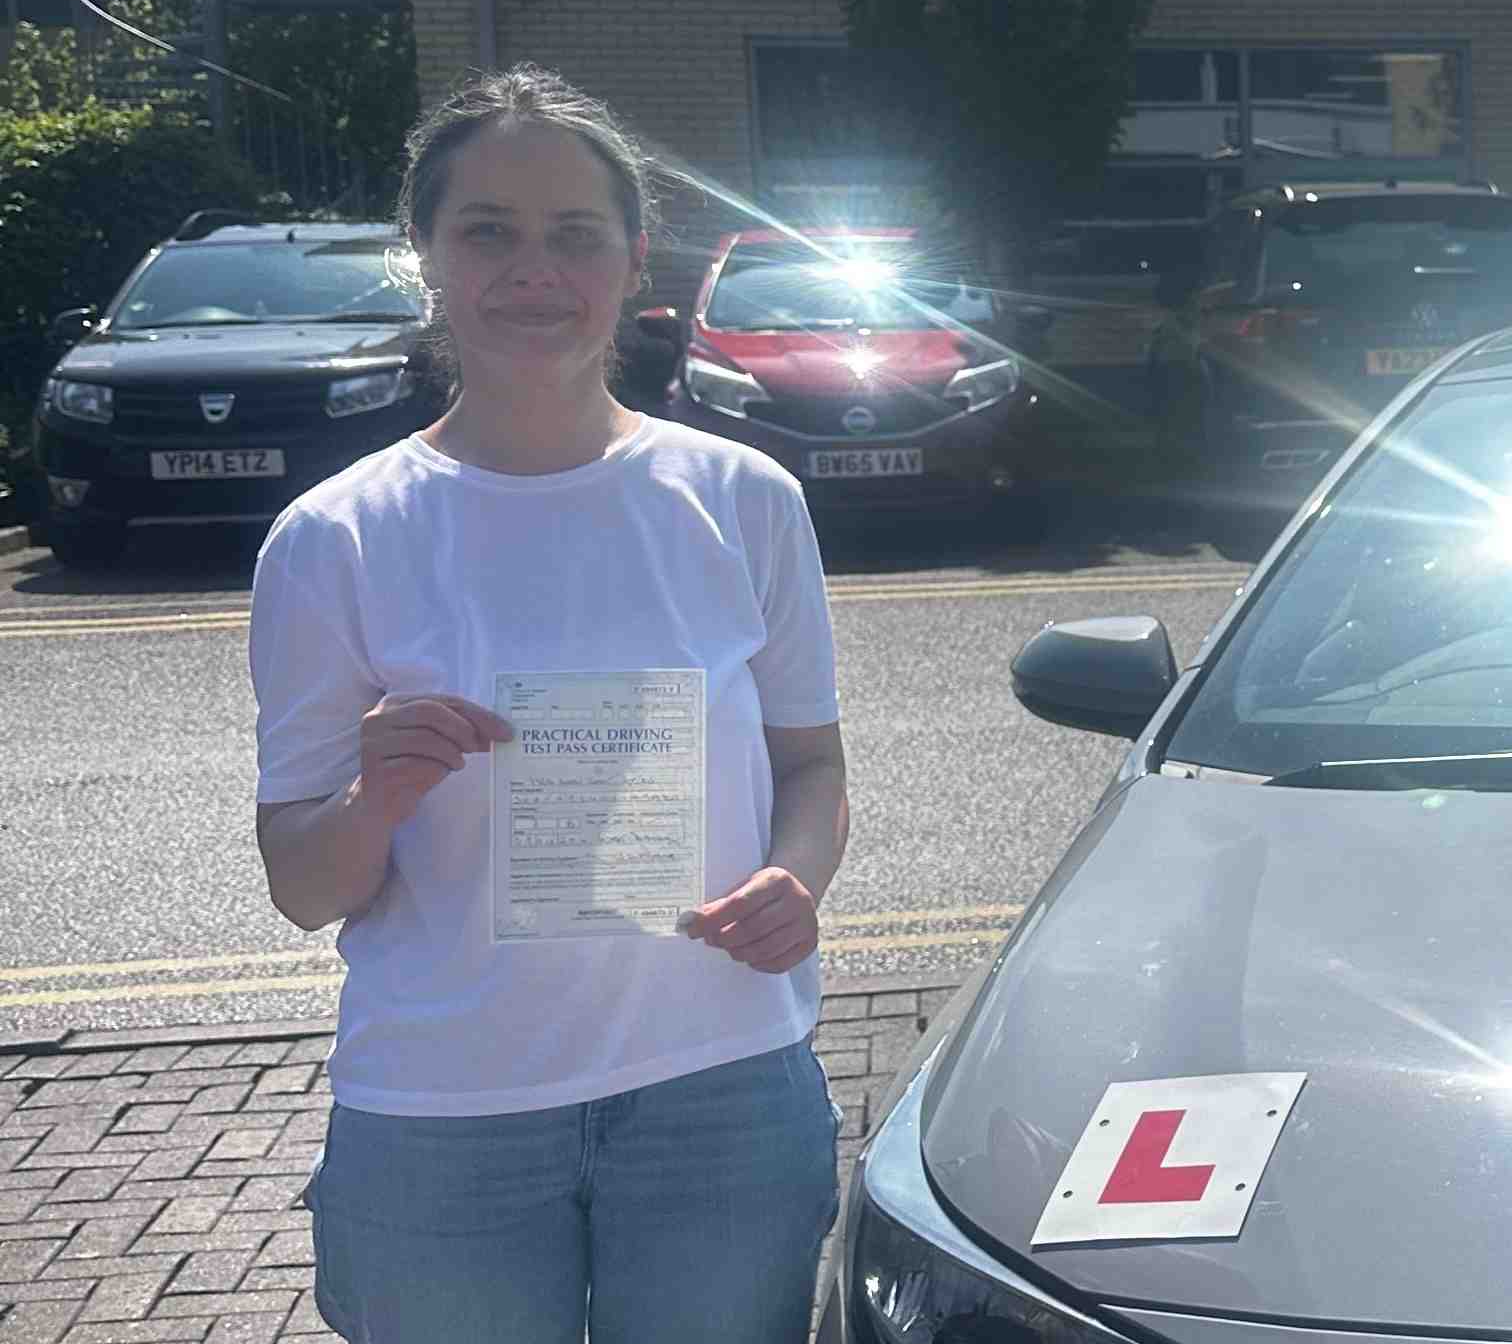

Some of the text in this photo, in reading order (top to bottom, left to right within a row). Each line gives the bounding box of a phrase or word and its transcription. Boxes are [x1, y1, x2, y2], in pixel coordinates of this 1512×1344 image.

[162, 451, 268, 474] YP14 ETZ
[521, 727, 673, 742] PRACTICAL DRIVING
[523, 742, 673, 754] TEST PASS CERTIFICATE
[1098, 1108, 1216, 1205] L
